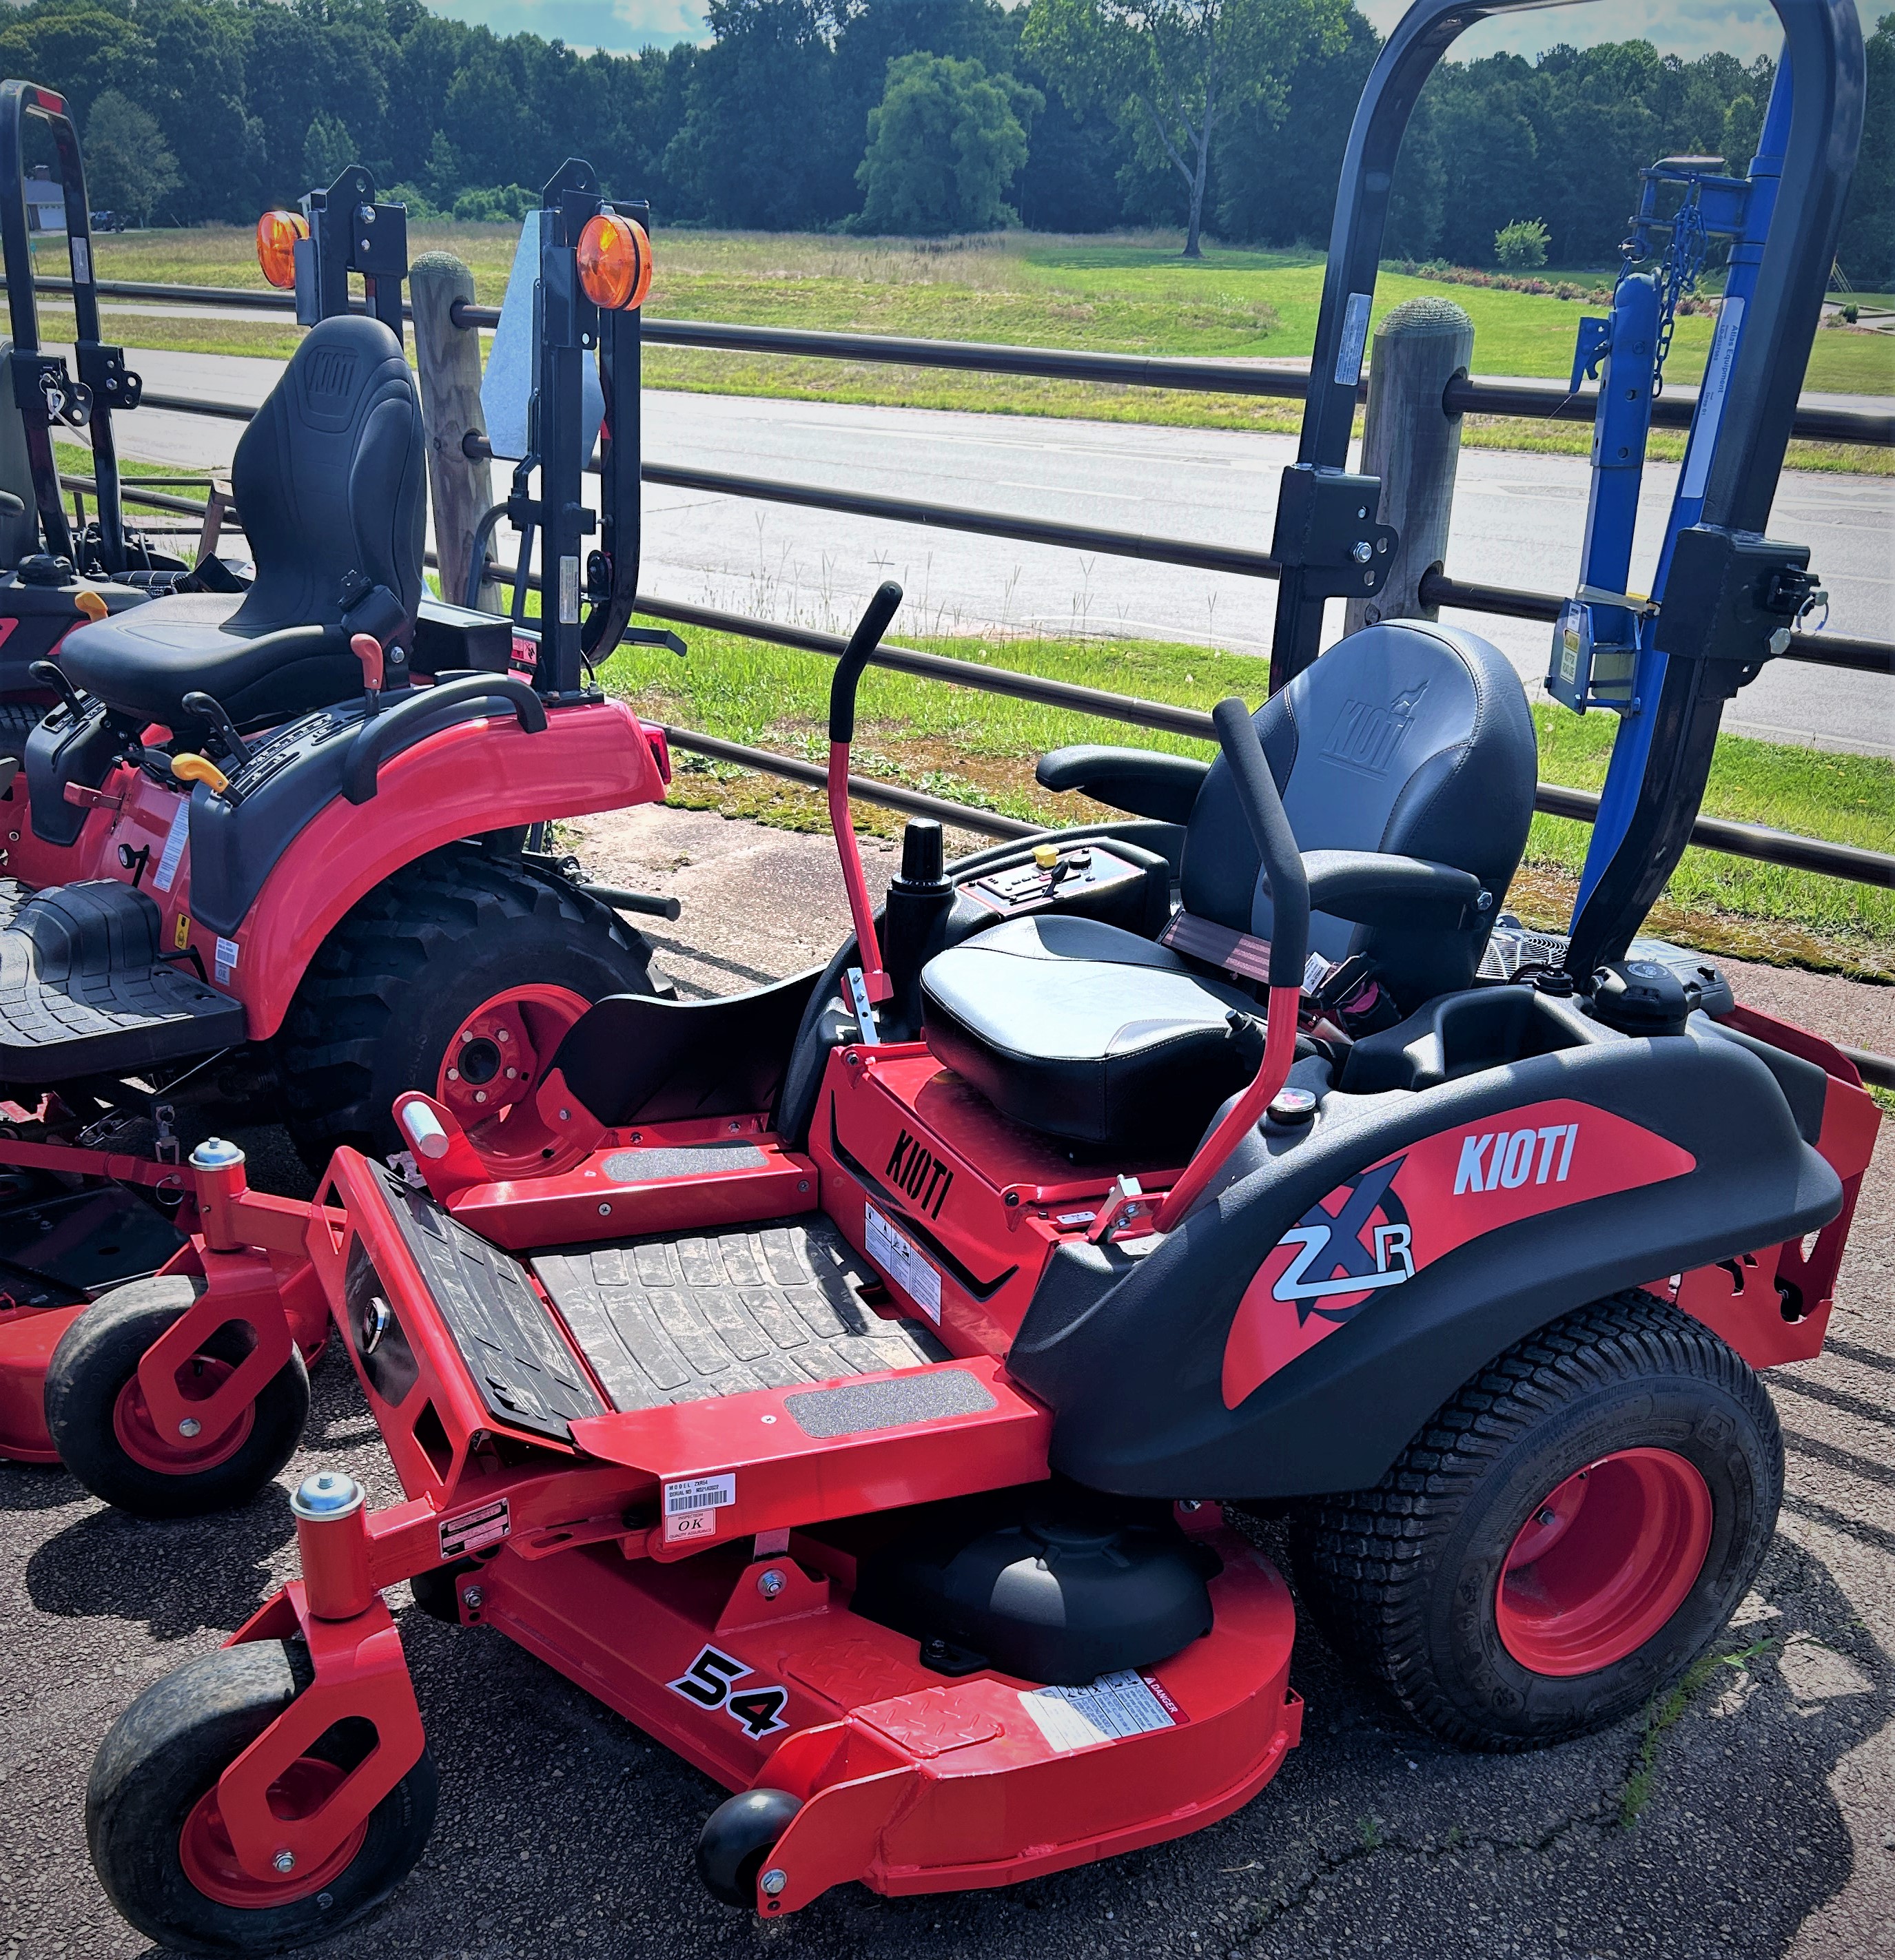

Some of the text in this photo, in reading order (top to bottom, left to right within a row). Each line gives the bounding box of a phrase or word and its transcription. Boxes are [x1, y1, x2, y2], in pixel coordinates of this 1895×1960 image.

[1728, 325, 1738, 346] Atlas
[1718, 349, 1733, 393] Equipment
[1322, 699, 1415, 772] KIOTI
[885, 1128, 954, 1221] KIOTI
[1453, 1124, 1579, 1195] KIOTI
[678, 1518, 704, 1531] OK
[665, 1643, 790, 1740] 54
[1151, 1683, 1178, 1713] DANGER
